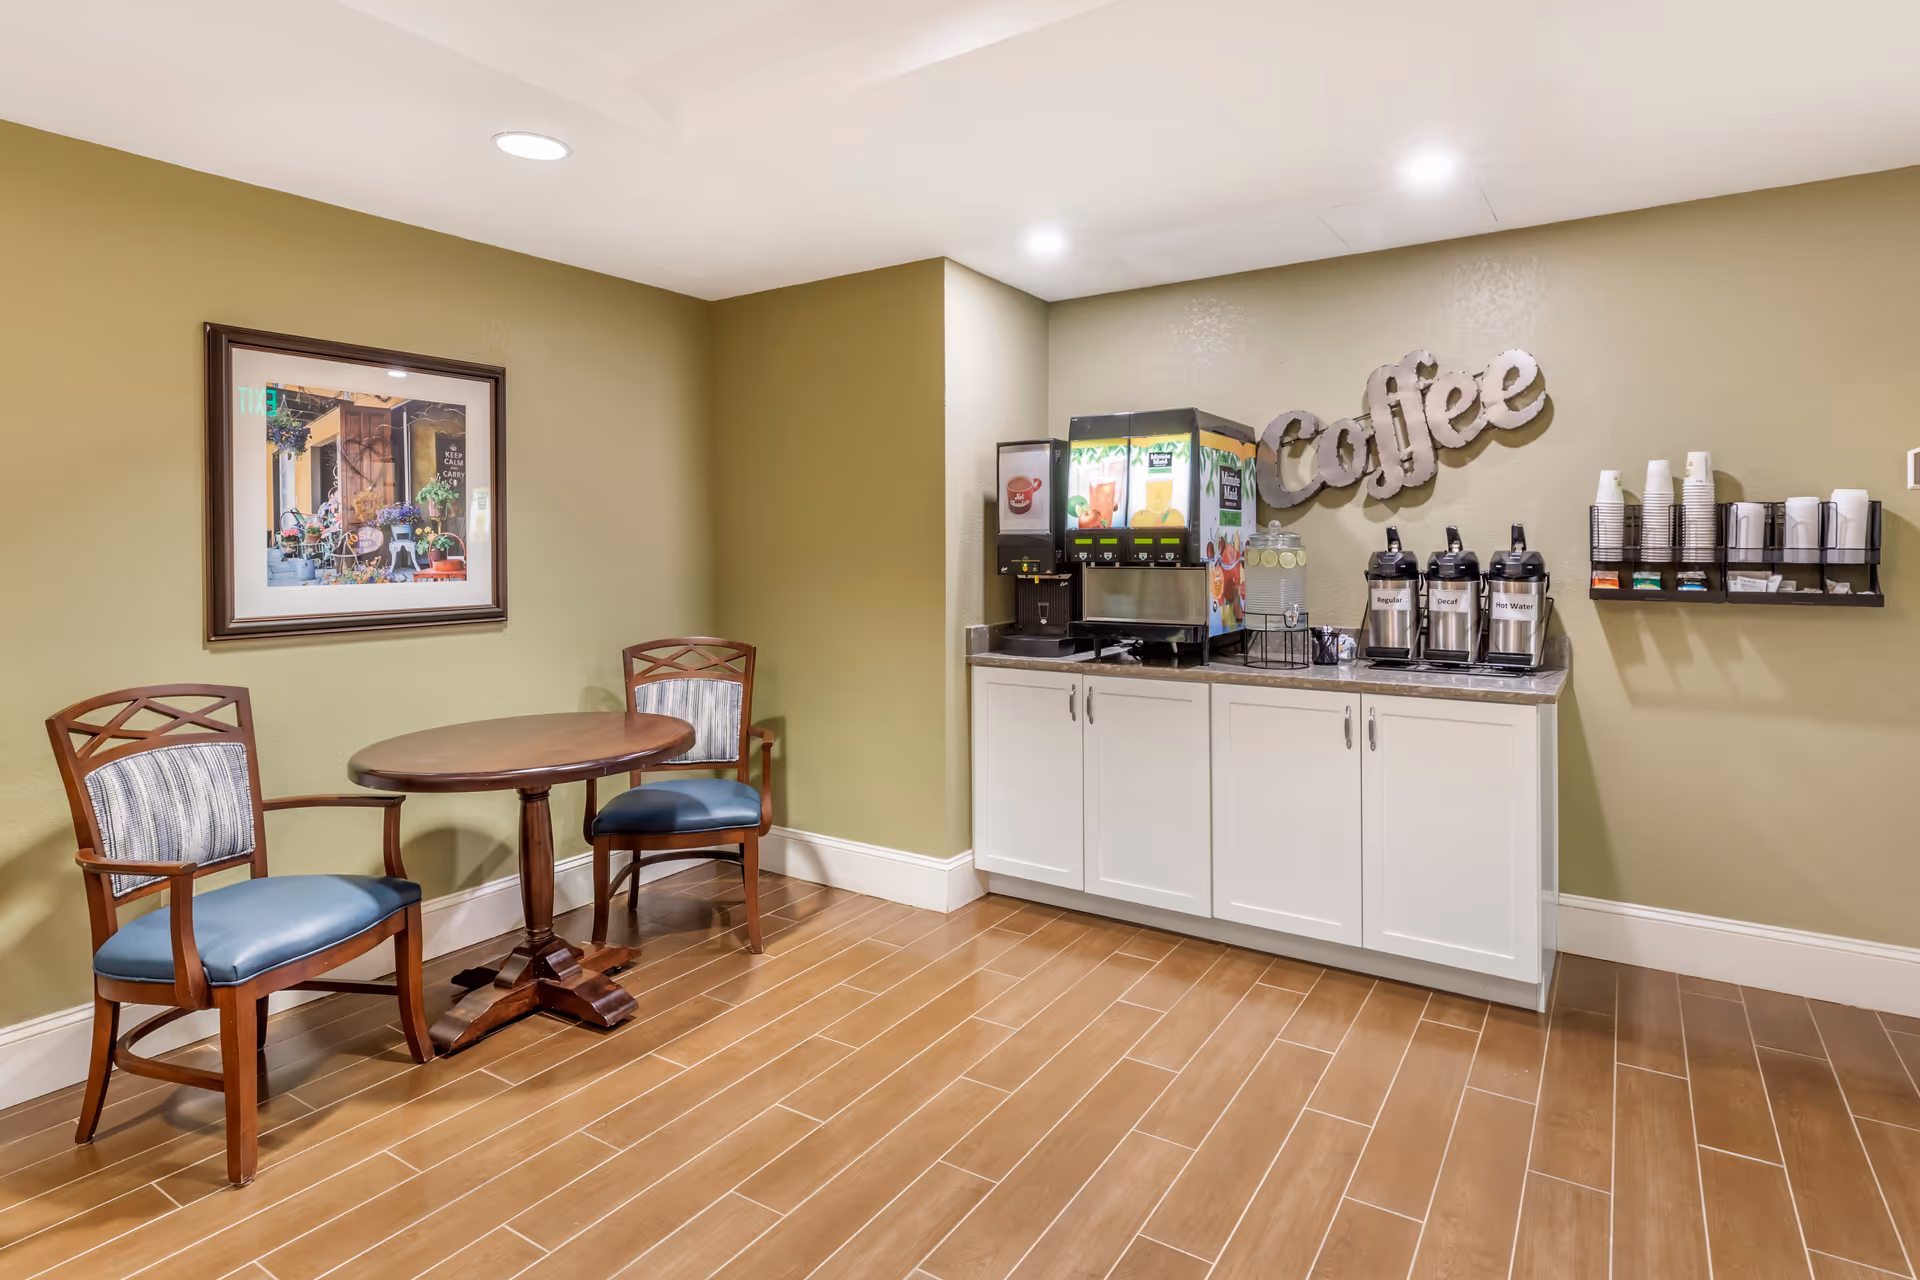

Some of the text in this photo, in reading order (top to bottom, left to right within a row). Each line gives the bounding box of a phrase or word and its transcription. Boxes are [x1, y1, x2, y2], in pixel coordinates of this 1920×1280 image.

[1256, 349, 1546, 508] Coffee
[445, 451, 462, 459] KEEP
[444, 458, 464, 466] CALM
[443, 471, 465, 479] CARRY
[1221, 471, 1240, 487] Minute
[1223, 485, 1238, 500] Maid
